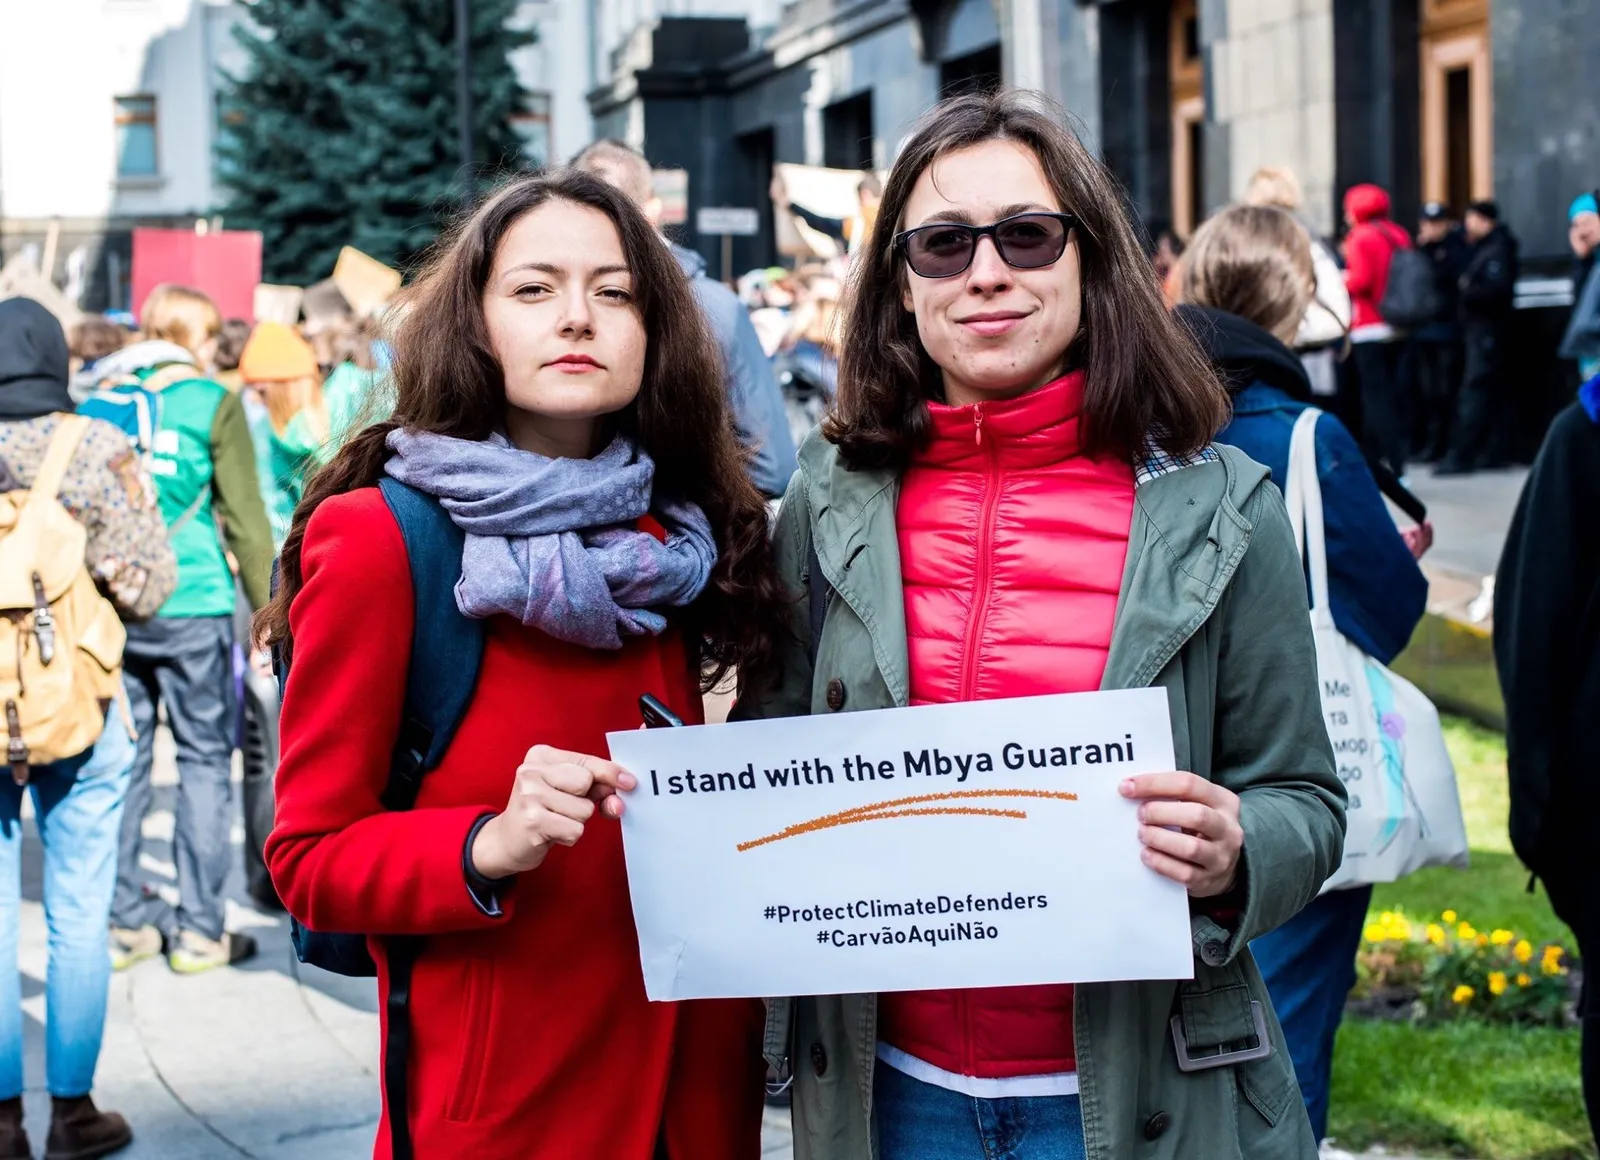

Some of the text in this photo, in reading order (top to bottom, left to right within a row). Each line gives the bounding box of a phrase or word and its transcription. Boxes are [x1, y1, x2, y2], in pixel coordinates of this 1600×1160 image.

[650, 733, 1135, 796] I stand with the Mbya Guarani
[763, 891, 1048, 924] #ProtectClimateDefenders
[816, 921, 999, 948] #CarvãoAquiNão
